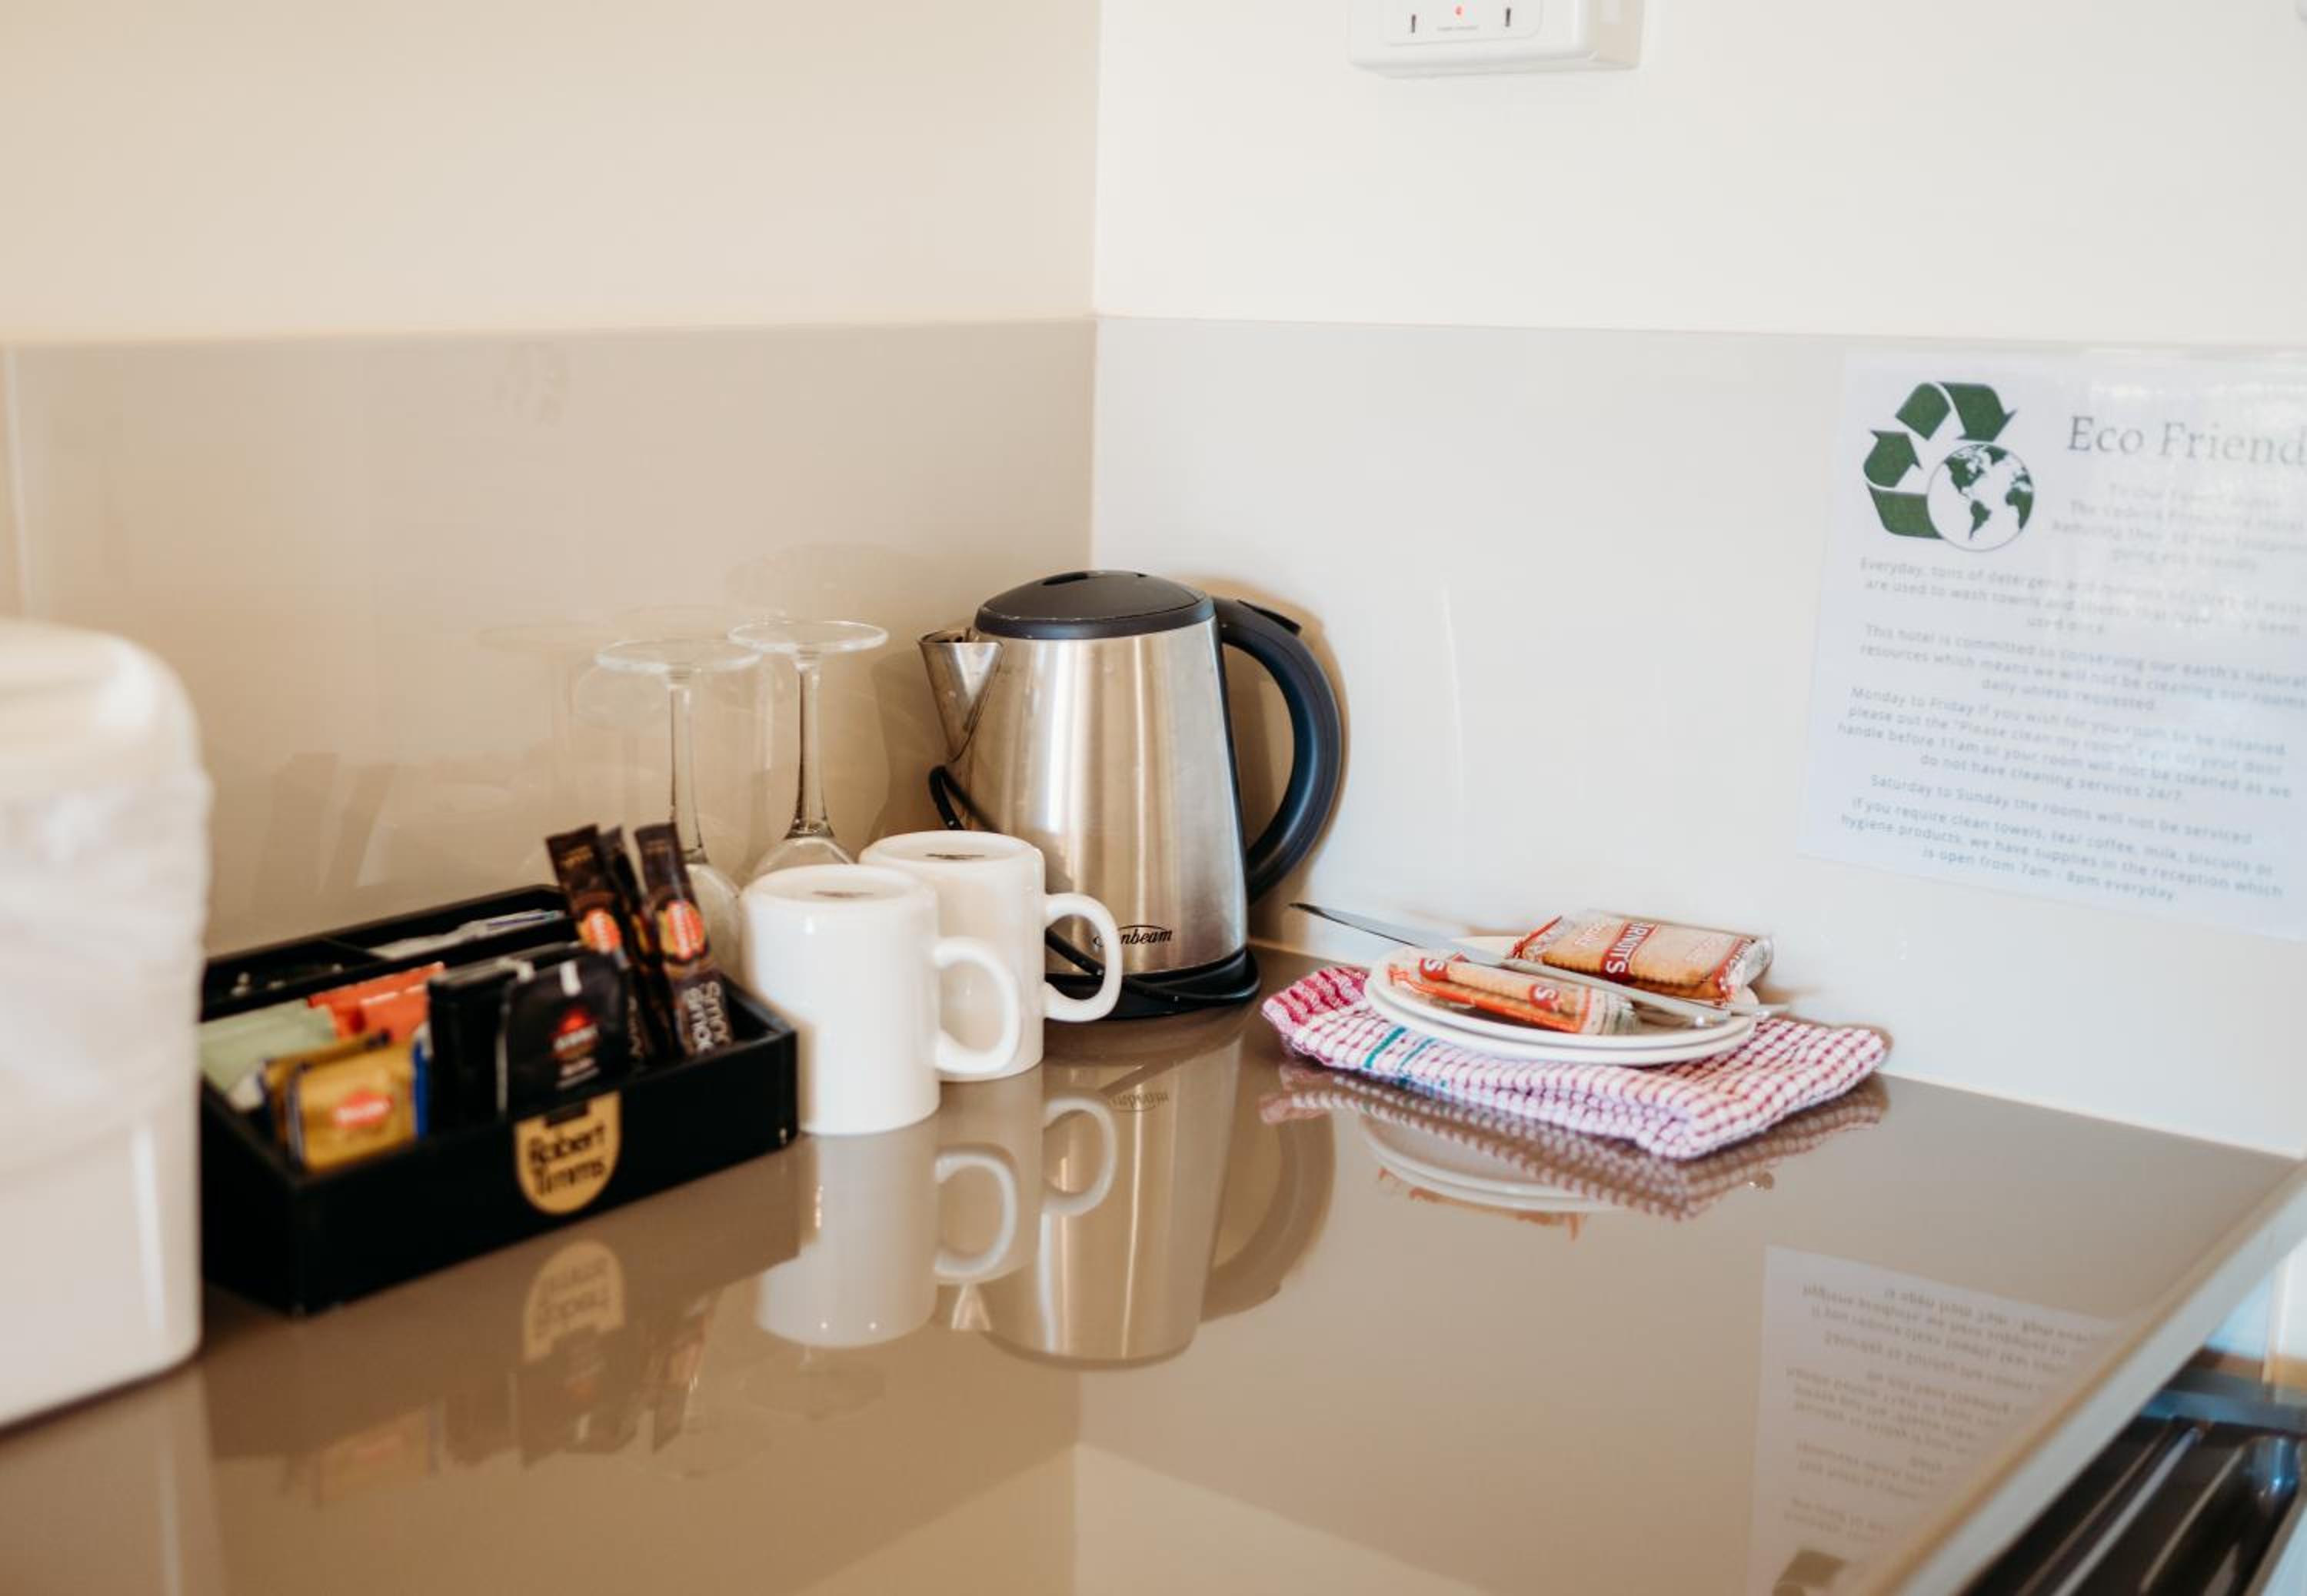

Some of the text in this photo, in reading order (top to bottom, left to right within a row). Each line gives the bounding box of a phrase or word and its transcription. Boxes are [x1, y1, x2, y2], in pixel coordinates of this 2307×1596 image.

[2067, 416, 2307, 467] Eco Friend
[1866, 623, 1893, 640] This
[1850, 686, 1906, 709] Monday
[1911, 695, 1926, 707] to
[1836, 721, 1883, 739] handle
[1888, 729, 1935, 748] before
[1919, 754, 1939, 766] do
[1972, 760, 2006, 776] have
[1869, 773, 1932, 798] Saturday
[1937, 786, 1952, 798] to
[1956, 787, 2009, 809] Sunday
[2013, 799, 2039, 813] the
[1896, 805, 1946, 825] require
[1951, 814, 1989, 830] clean
[1840, 813, 1894, 833] hygiene
[1995, 839, 2029, 855] have
[2121, 860, 2148, 876] the
[2152, 866, 2230, 889] reception
[2234, 879, 2284, 898] which
[1939, 850, 1974, 866] open
[1979, 854, 2015, 873] from
[528, 1122, 604, 1164] Robert
